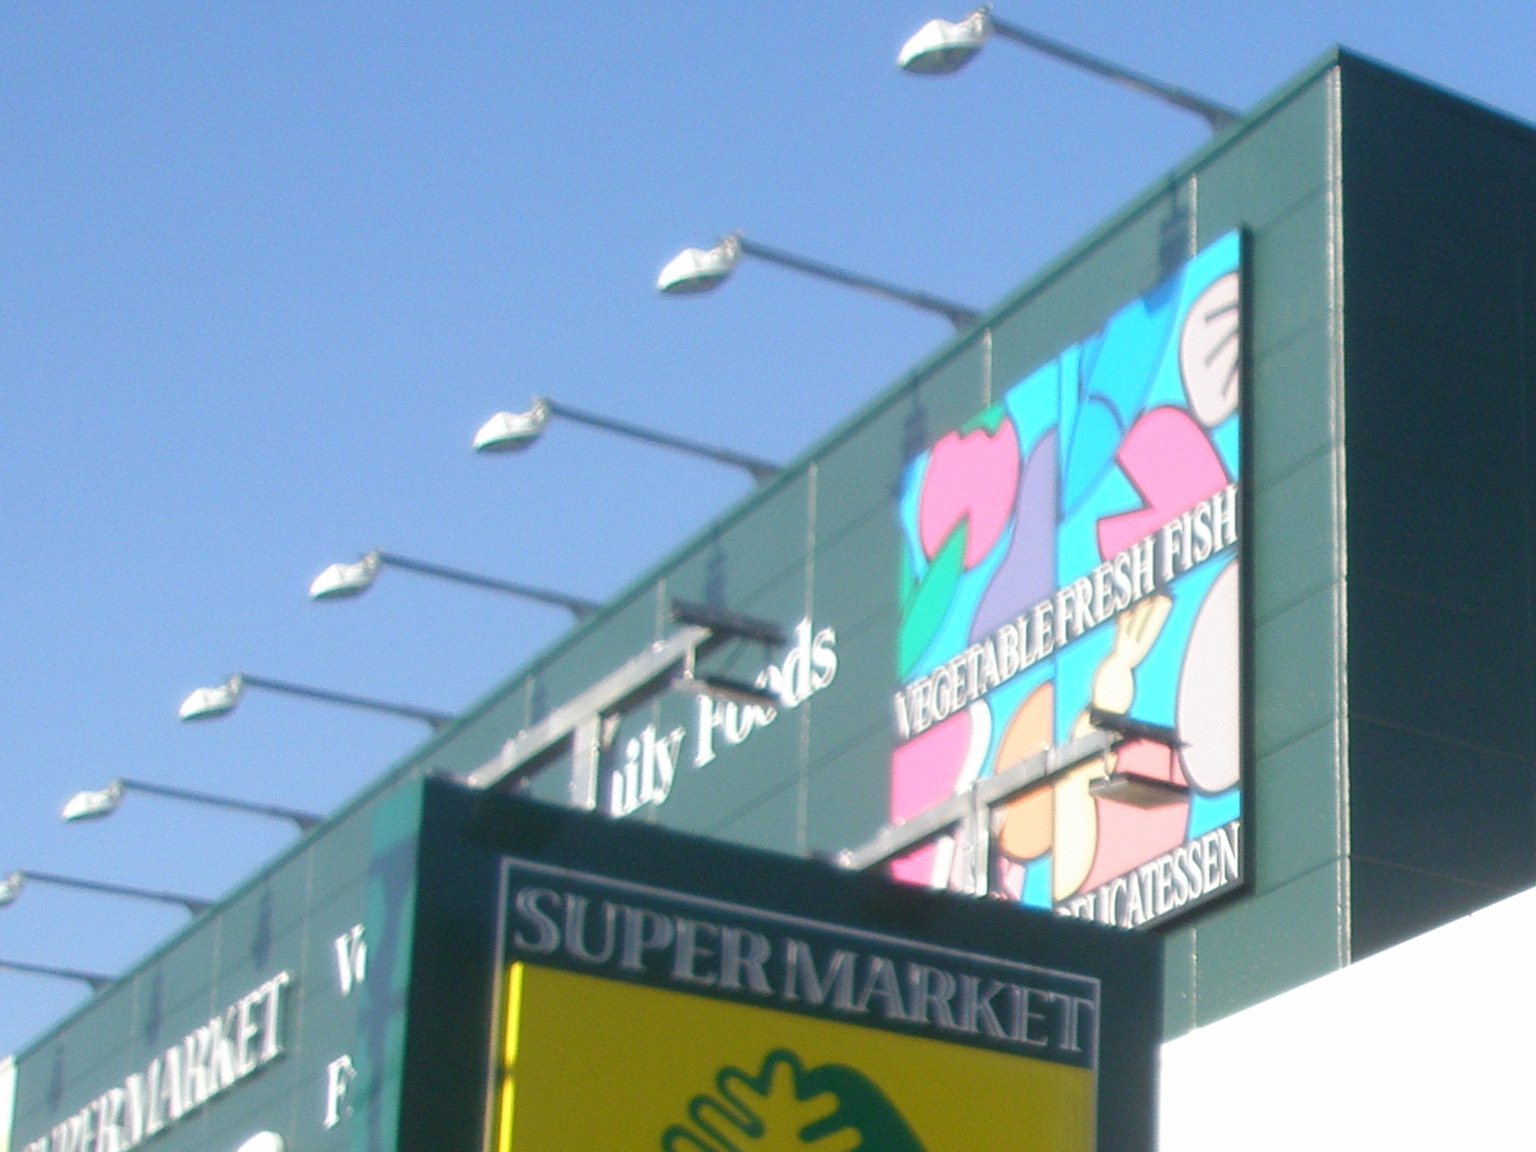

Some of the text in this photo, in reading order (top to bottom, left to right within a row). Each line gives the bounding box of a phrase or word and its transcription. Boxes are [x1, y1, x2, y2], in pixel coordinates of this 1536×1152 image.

[893, 482, 1239, 739] VEGETABLE FRESH FISH
[513, 886, 1096, 1053] SUPER MARKET
